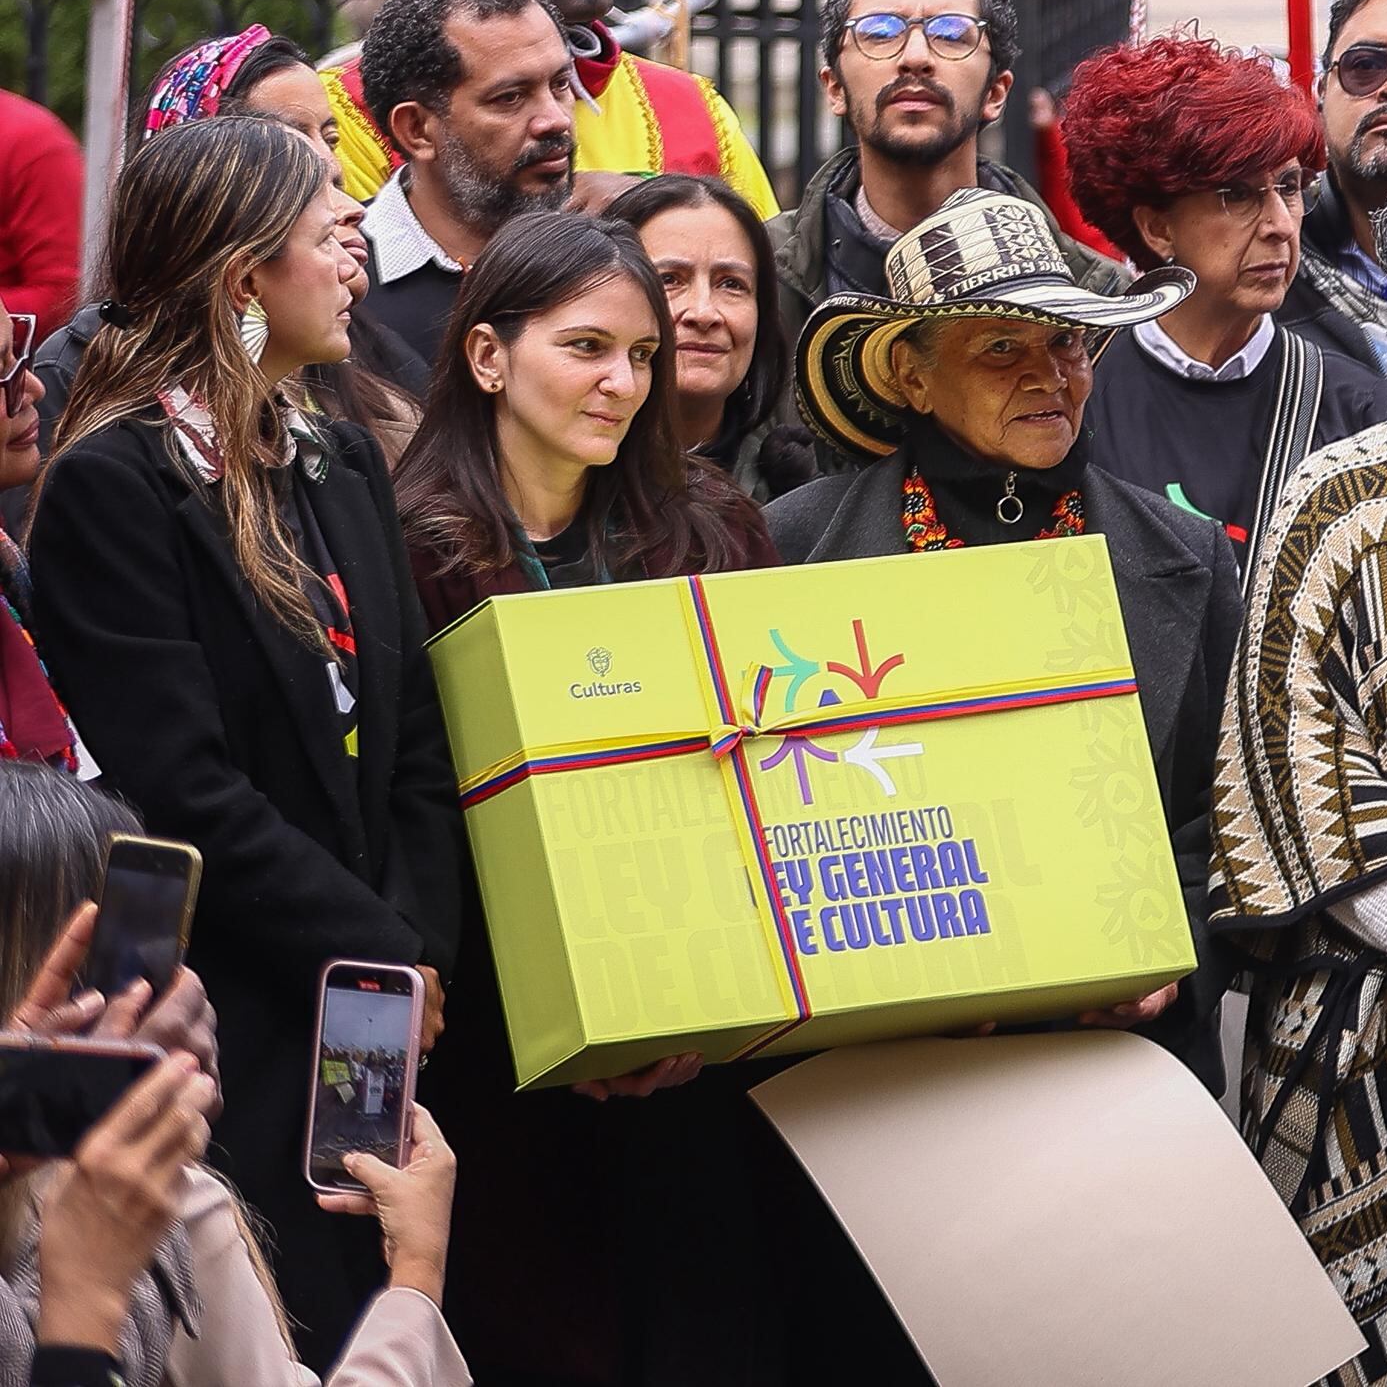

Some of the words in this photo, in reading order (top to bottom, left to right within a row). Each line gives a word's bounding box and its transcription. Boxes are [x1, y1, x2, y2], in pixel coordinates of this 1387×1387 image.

[950, 263, 1021, 296] TIERRA
[569, 680, 642, 699] Culturas
[762, 805, 954, 859] FORTALECIMIENTO
[745, 859, 815, 910] EY
[818, 838, 990, 902] GENERAL
[818, 888, 993, 953] CULTURA
